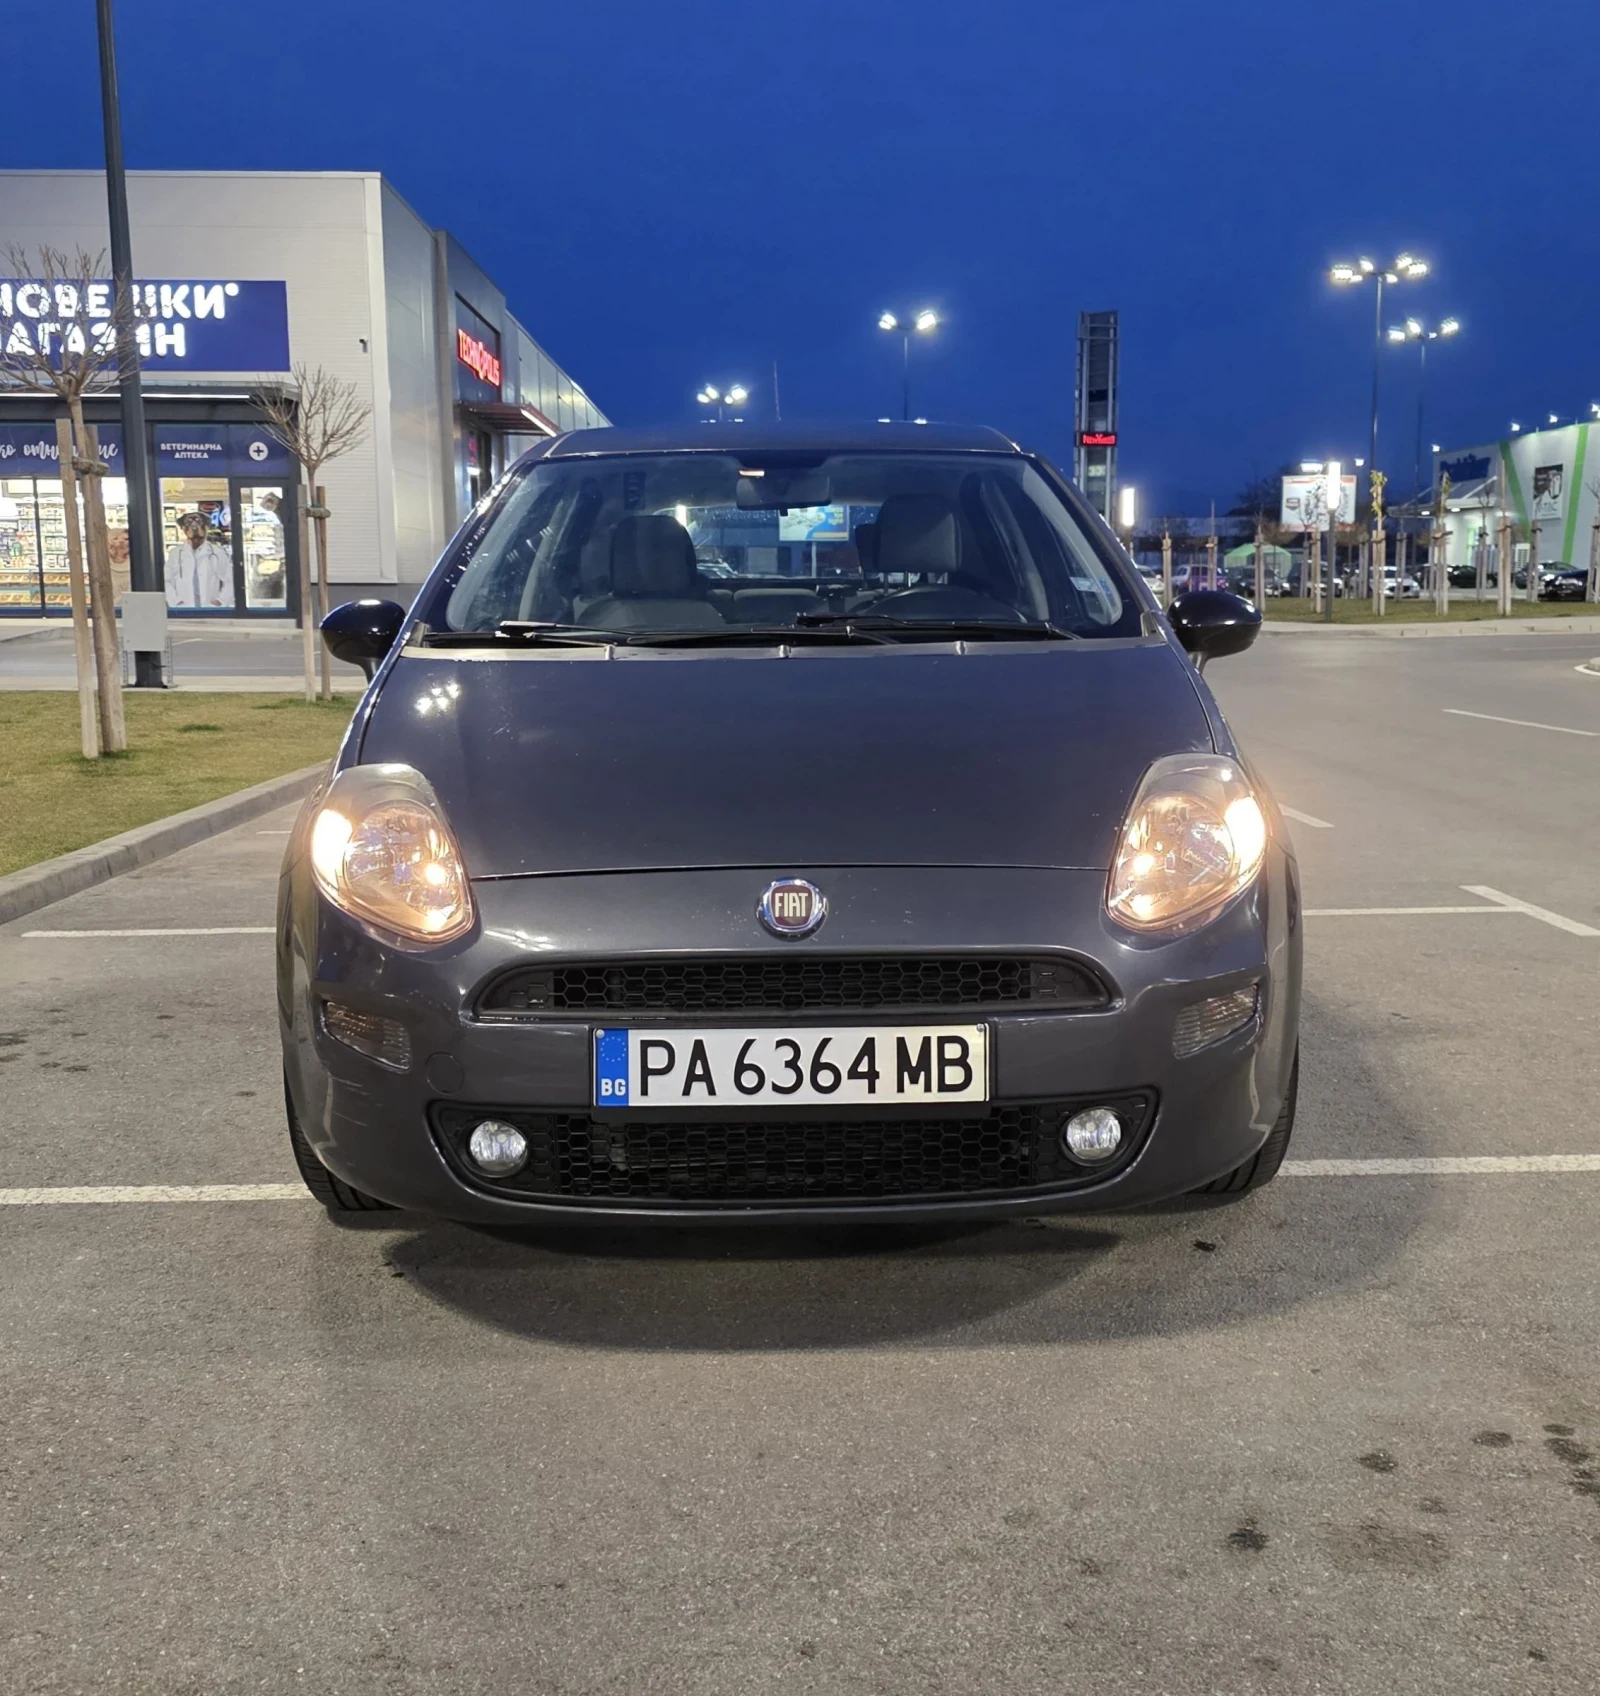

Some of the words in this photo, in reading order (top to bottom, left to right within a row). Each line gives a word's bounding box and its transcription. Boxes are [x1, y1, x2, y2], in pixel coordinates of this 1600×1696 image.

[0, 321, 186, 357] АГАЗН
[160, 443, 222, 451] ВЕТЕРИНАРНА
[174, 451, 209, 459] АПТЕКА
[774, 892, 809, 917] FIAT
[640, 1038, 717, 1096] PA
[733, 1037, 880, 1095] 6364
[896, 1035, 973, 1094] MB
[600, 1078, 627, 1096] BG
